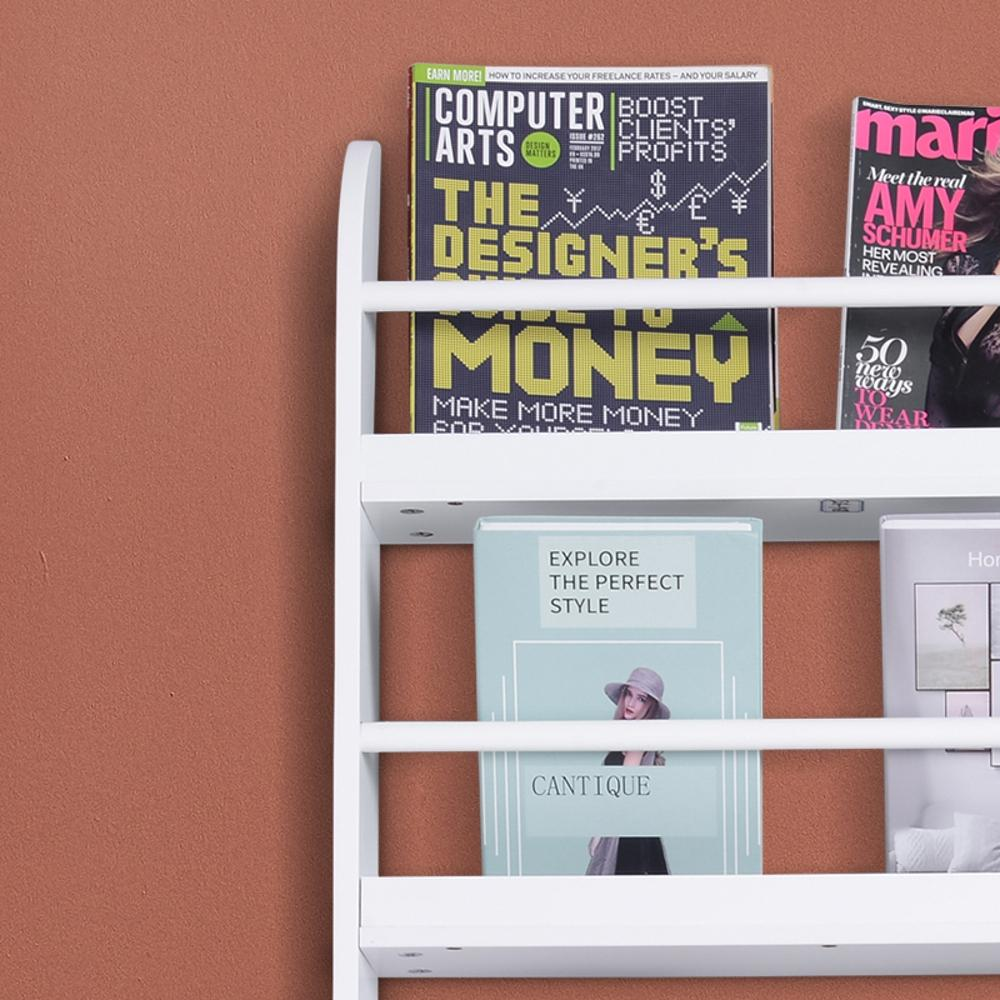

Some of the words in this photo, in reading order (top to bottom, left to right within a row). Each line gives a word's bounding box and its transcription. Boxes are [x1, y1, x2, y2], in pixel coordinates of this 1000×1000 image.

[427, 68, 450, 81] EARN
[523, 72, 566, 80] INCREASE
[592, 72, 640, 80] FREELANCE
[680, 71, 698, 79] AND
[700, 71, 722, 79] YOUR
[724, 70, 758, 79] SALARY
[435, 87, 604, 130] COMPUTER
[619, 96, 703, 118] BOOST
[435, 127, 515, 167] ARTS
[525, 141, 550, 150] DESIGN
[525, 149, 556, 158] MATTERS
[619, 141, 727, 162] PROFITS
[866, 166, 906, 185] Meet
[907, 170, 933, 186] the
[933, 174, 967, 189] real
[433, 178, 539, 227] THE
[864, 181, 966, 230] AMY
[862, 222, 968, 253] SCHUMER
[863, 245, 891, 260] HER
[893, 249, 937, 264] MOST
[862, 258, 943, 277] REVEALING
[433, 319, 750, 403] MONEY
[855, 335, 908, 366] 50
[855, 361, 902, 380] new
[854, 374, 913, 398] ways
[854, 387, 887, 406] TO
[433, 395, 508, 420] MAKE
[518, 401, 593, 424] MORE
[603, 405, 704, 428] MONEY
[854, 402, 929, 428] WEAR
[549, 550, 640, 567] EXPLORE
[549, 574, 589, 590] THE
[596, 574, 684, 590] PERFECT
[550, 598, 609, 614] STYLE
[532, 774, 650, 798] CANTIQUE
